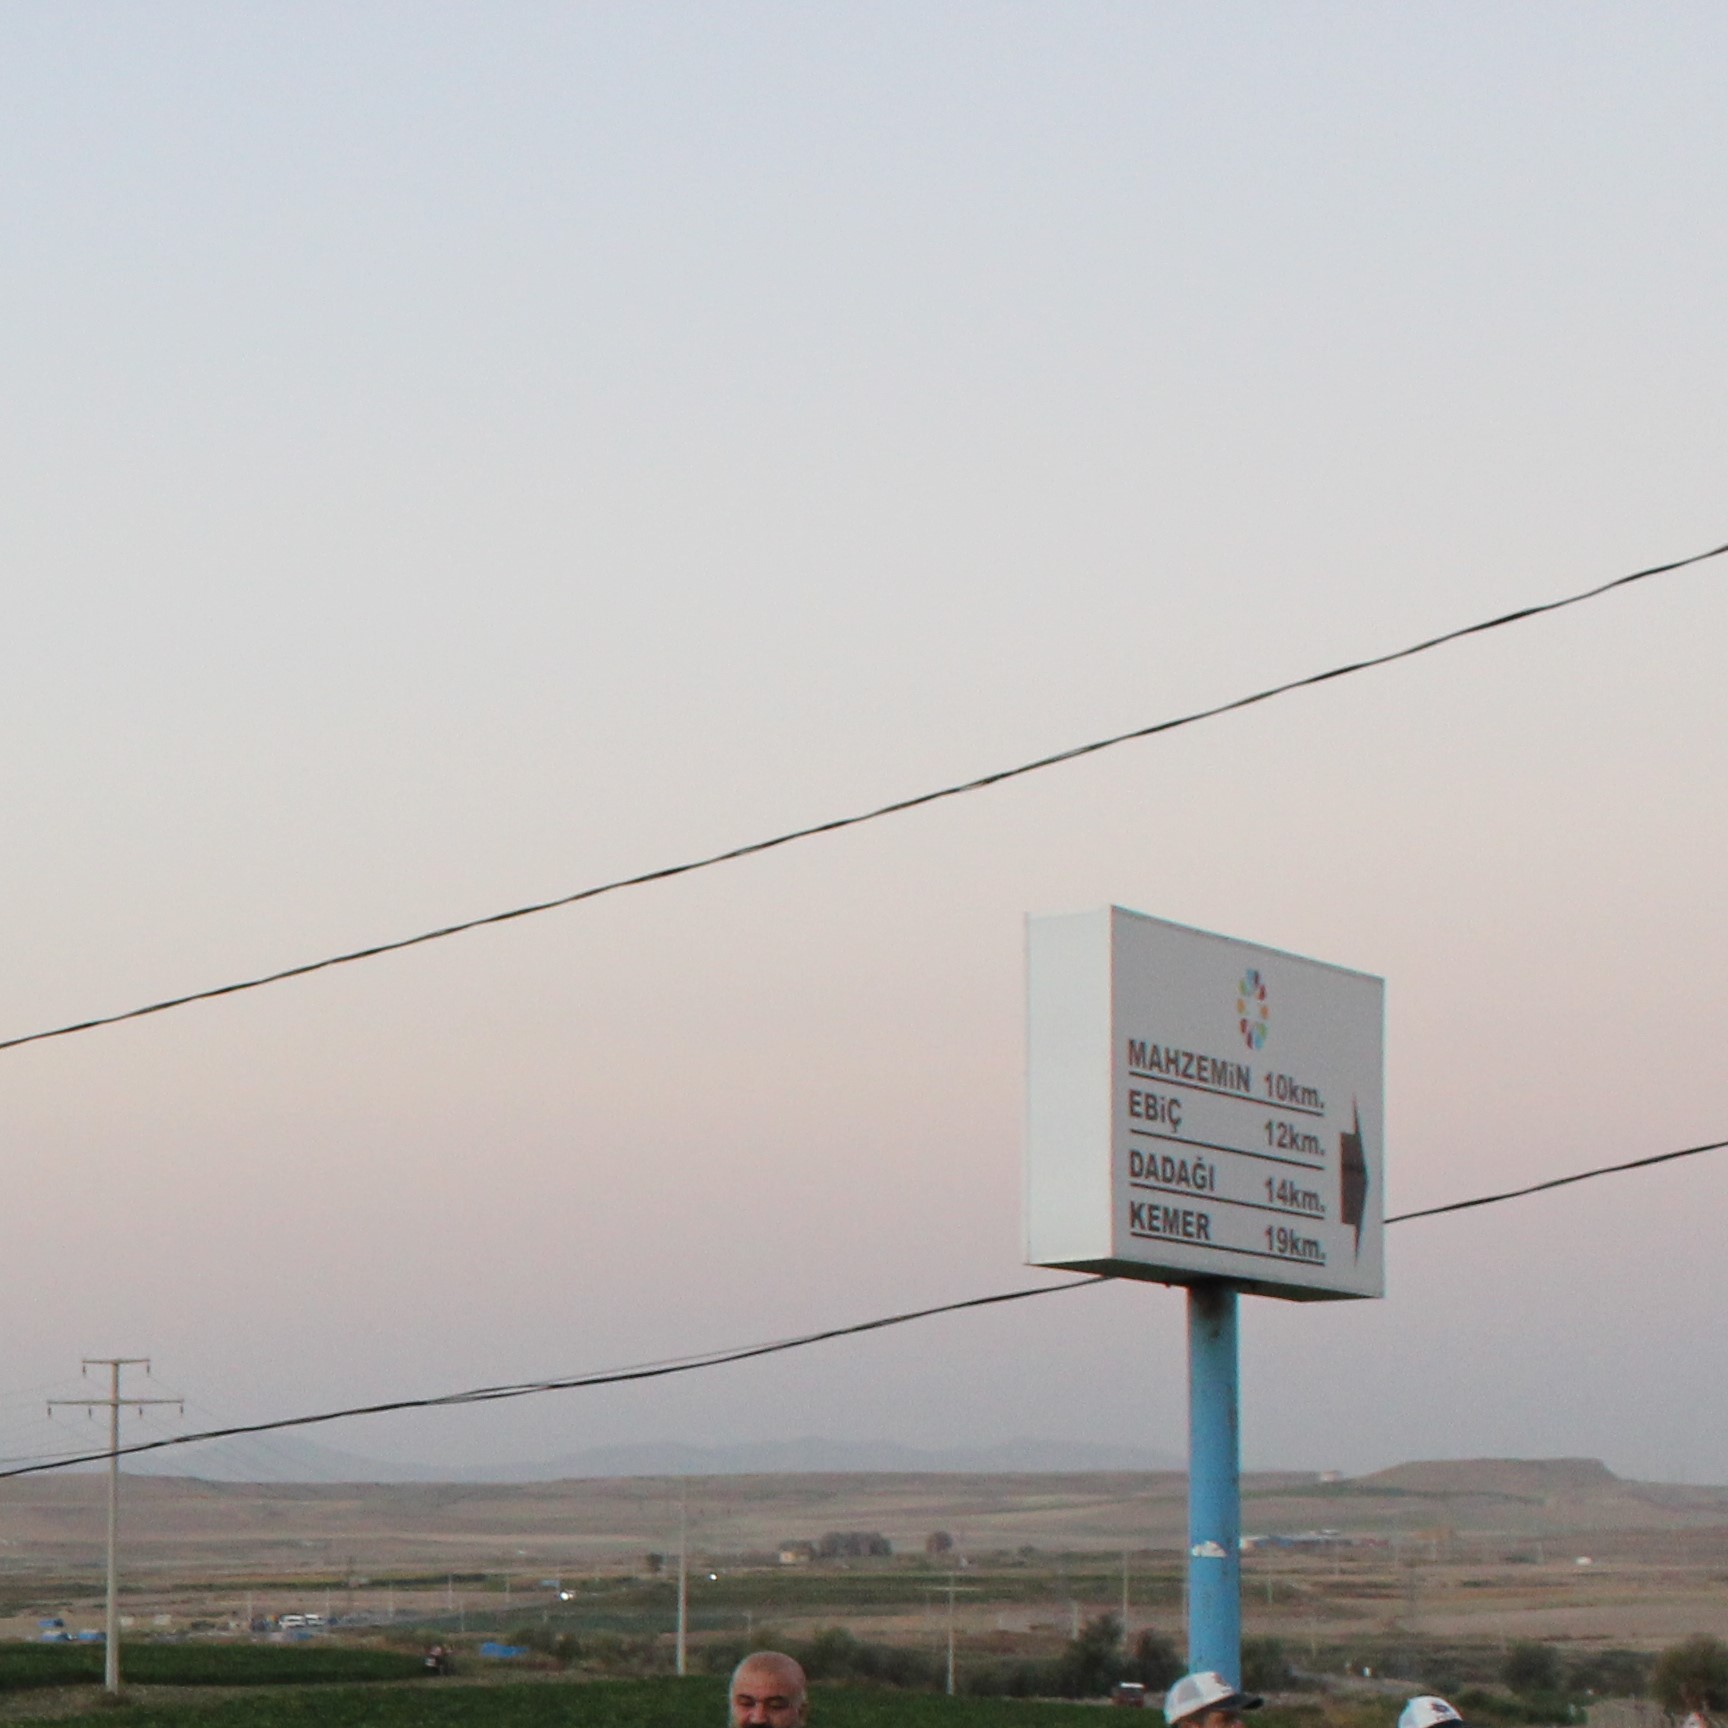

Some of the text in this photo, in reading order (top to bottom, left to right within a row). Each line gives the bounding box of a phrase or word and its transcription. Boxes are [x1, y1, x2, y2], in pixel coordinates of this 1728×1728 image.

[1265, 1071, 1324, 1109] 10km.
[1264, 1118, 1325, 1156] 12km.
[1129, 1149, 1326, 1213] DADAĞI 14km.
[1129, 1201, 1326, 1260] KEMER 19km.
